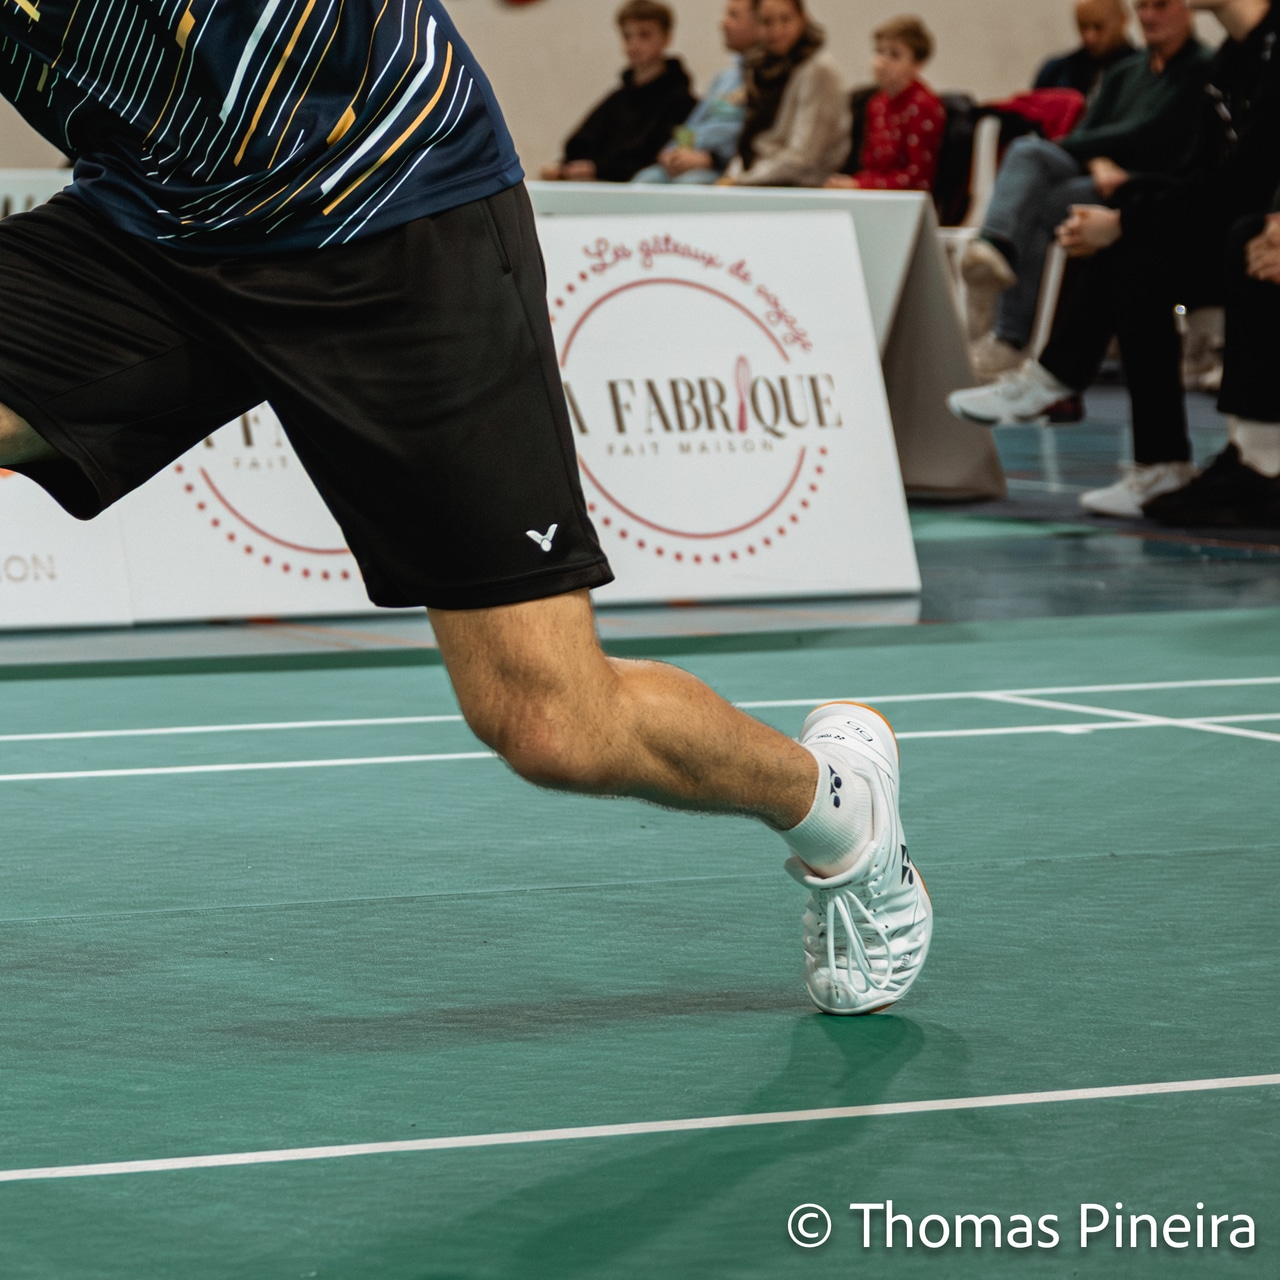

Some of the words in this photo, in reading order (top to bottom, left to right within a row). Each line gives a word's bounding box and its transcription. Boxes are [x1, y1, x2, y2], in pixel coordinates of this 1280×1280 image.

[582, 237, 632, 275] Les
[728, 259, 752, 286] de
[606, 356, 842, 438] FABRIQUE
[606, 442, 660, 457] FAIT
[678, 439, 775, 455] MAISON
